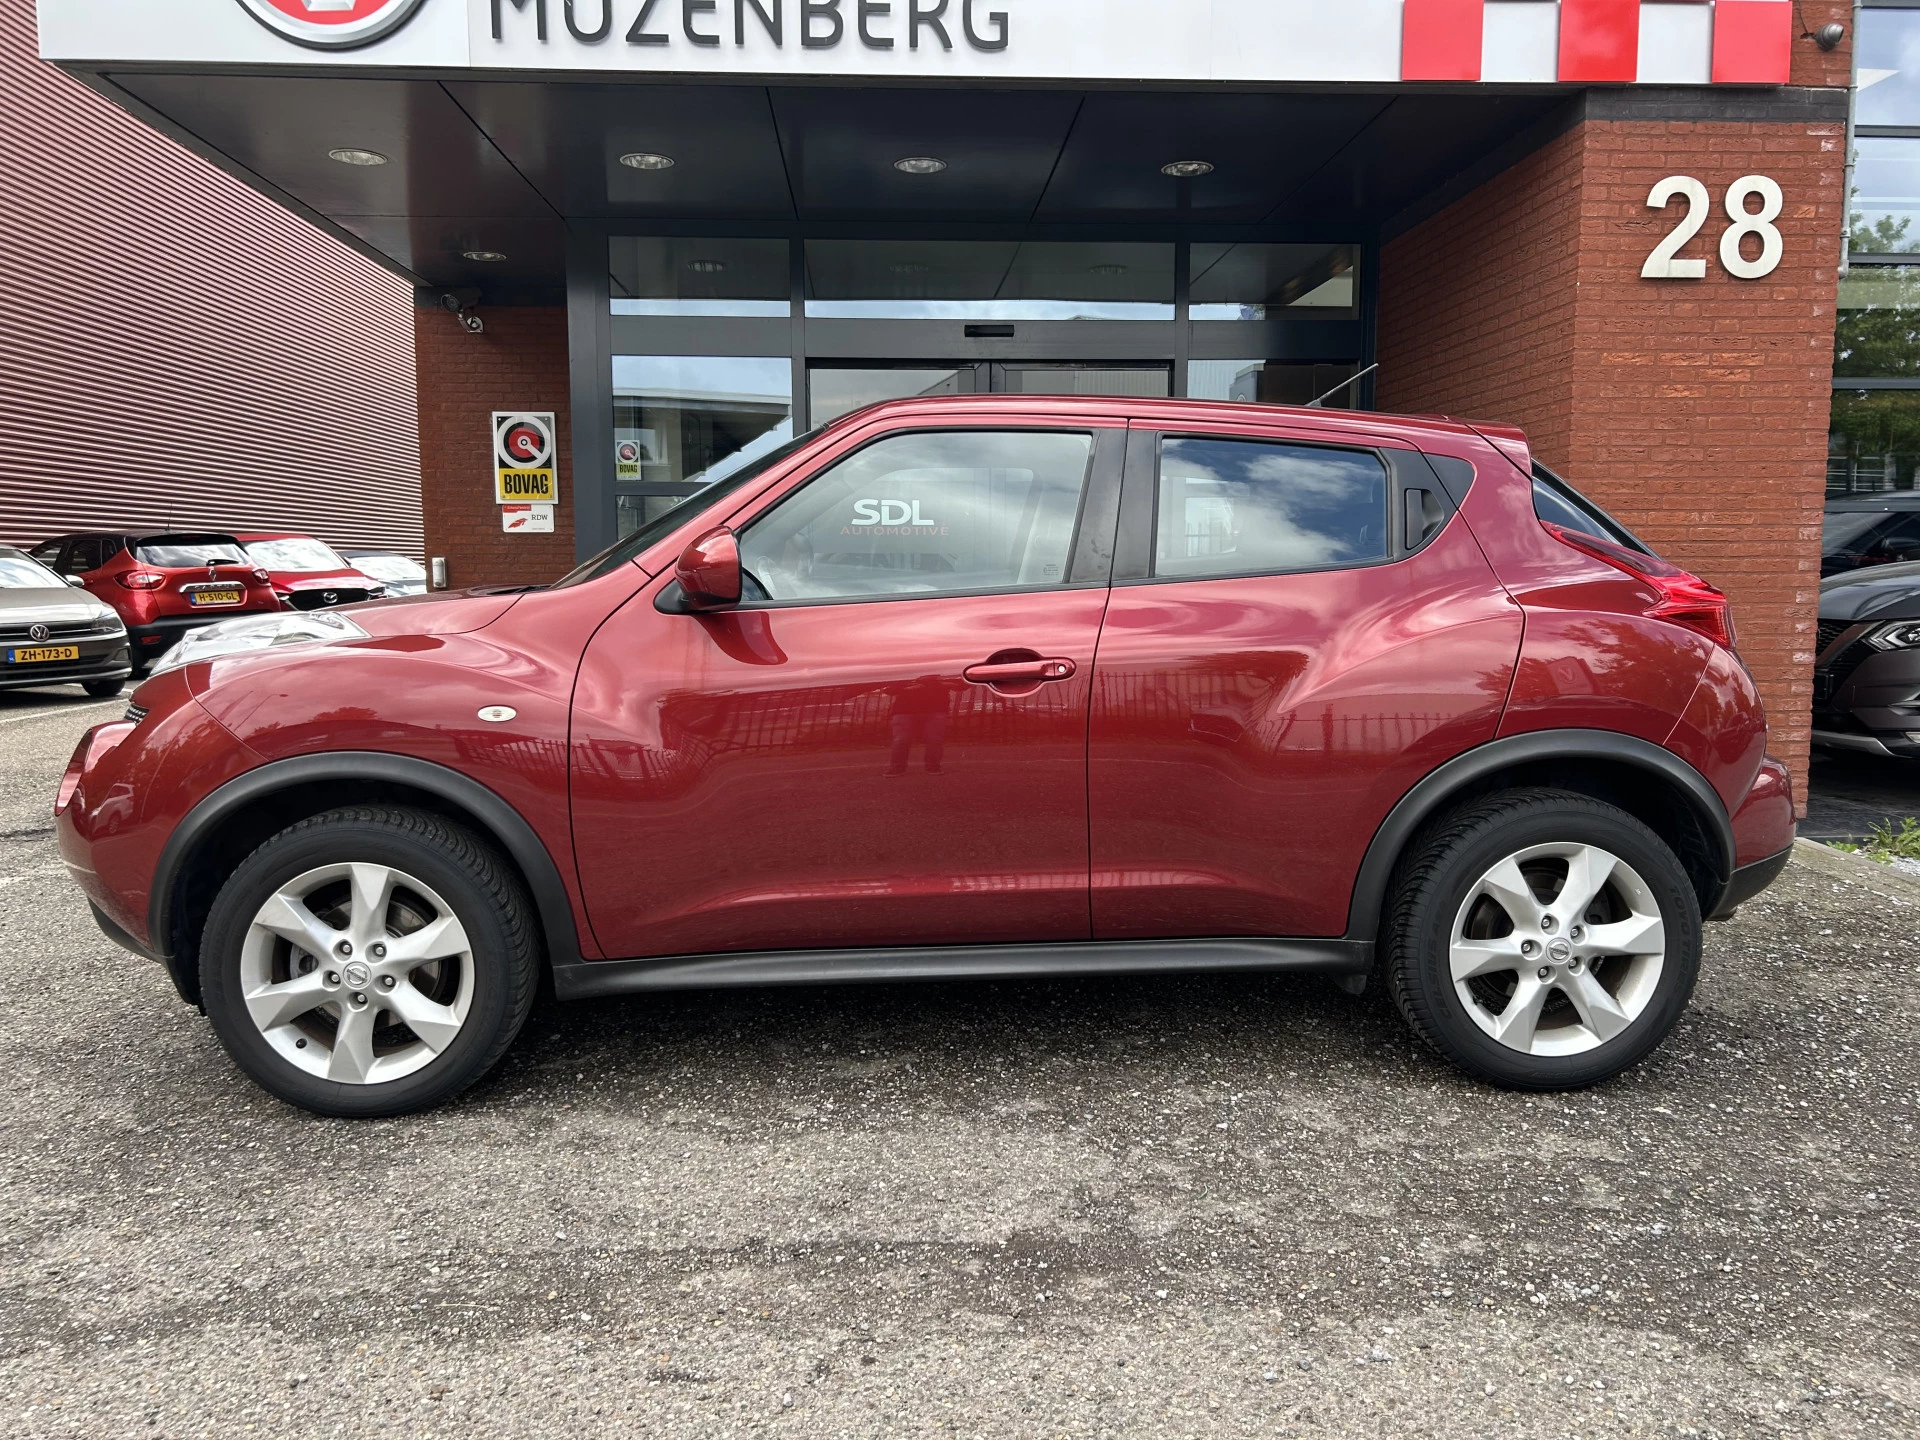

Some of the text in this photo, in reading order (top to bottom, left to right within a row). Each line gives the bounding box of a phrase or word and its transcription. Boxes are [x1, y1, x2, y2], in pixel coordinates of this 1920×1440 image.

[1641, 175, 1783, 279] 28
[620, 464, 638, 473] BOVAG
[504, 474, 549, 494] BOVAG
[851, 499, 934, 526] SDL
[840, 526, 949, 536] AUTOMOTIVE
[199, 592, 237, 603] H-510-GL
[20, 648, 72, 661] ZH-173-D
